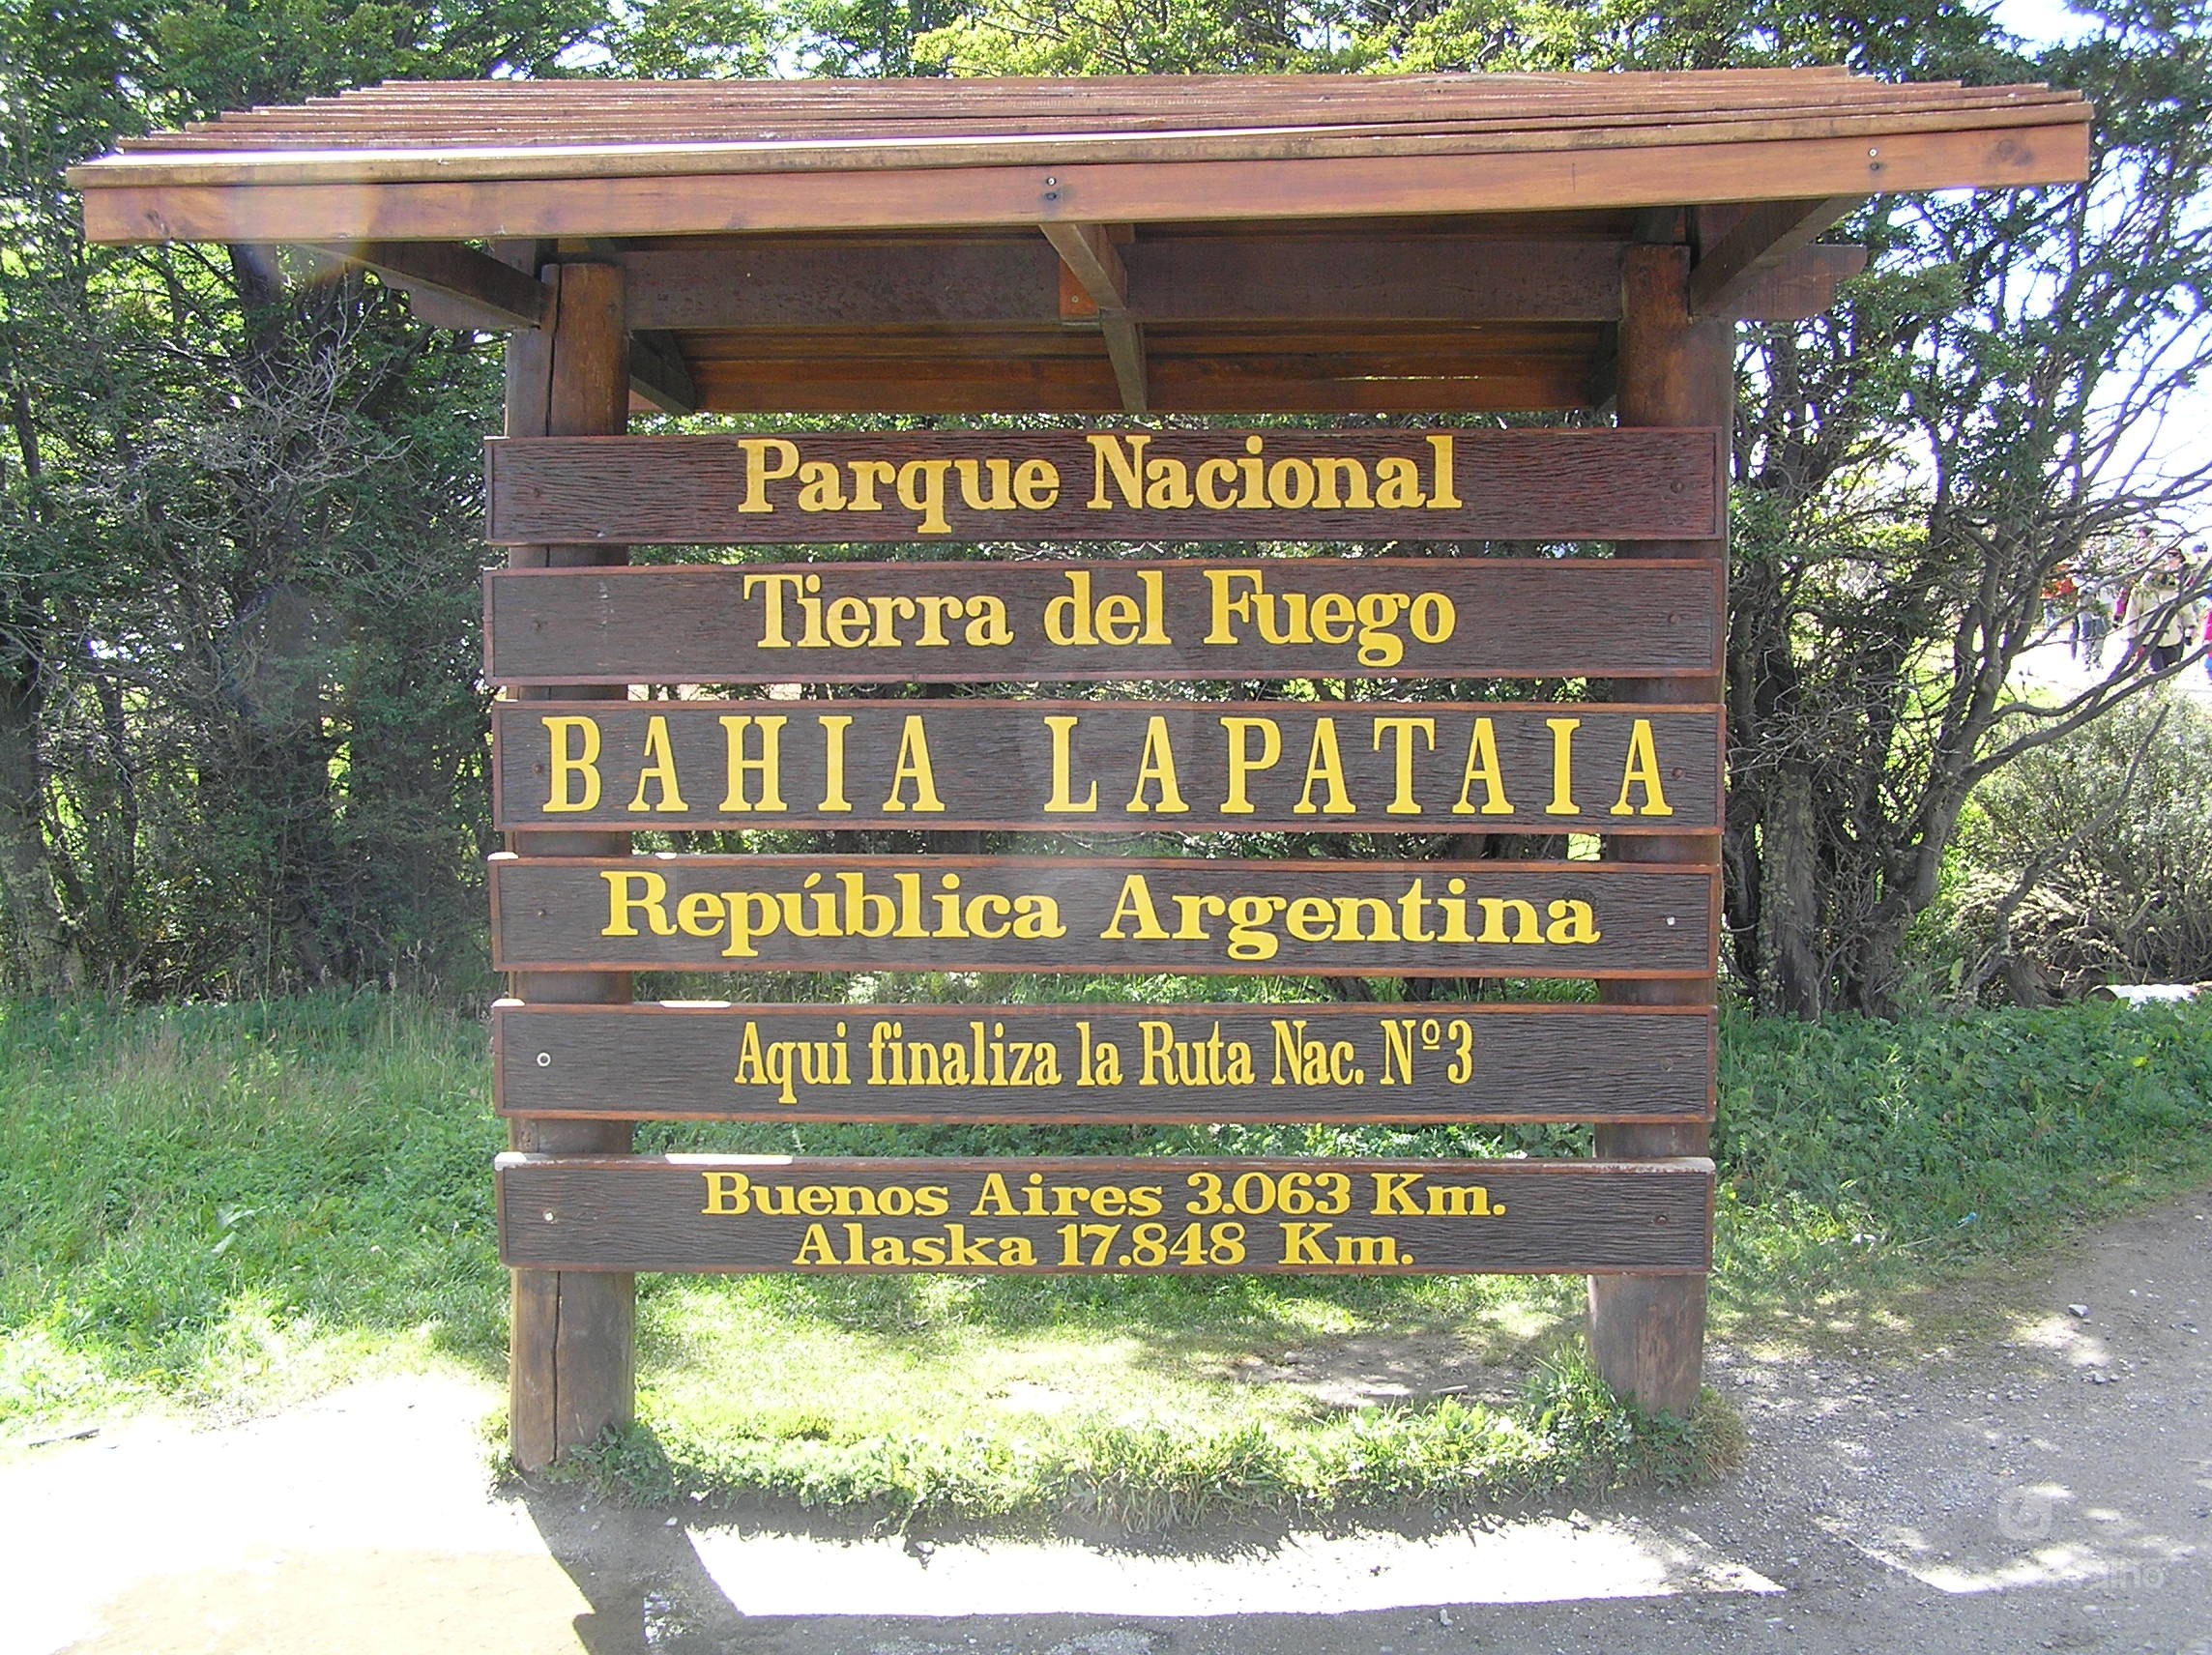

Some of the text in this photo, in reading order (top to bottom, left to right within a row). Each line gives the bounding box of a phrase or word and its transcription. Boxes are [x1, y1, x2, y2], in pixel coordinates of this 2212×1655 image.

[738, 435, 1462, 534] Parque Nacional
[744, 568, 1455, 667] Tierra del Fuego
[542, 715, 1674, 817] BAHIA LAPATAIA
[601, 867, 1600, 960] República Argentina
[735, 1022, 851, 1105] Aqui
[868, 1021, 1061, 1086] finaliza
[1077, 1022, 1122, 1087] la
[1139, 1021, 1255, 1087] Ruta
[1272, 1020, 1364, 1087] Nac.
[702, 1171, 1506, 1216] Buenos Aires 3.063 Km.
[794, 1222, 1413, 1267] Alaska 17.848 Km.
